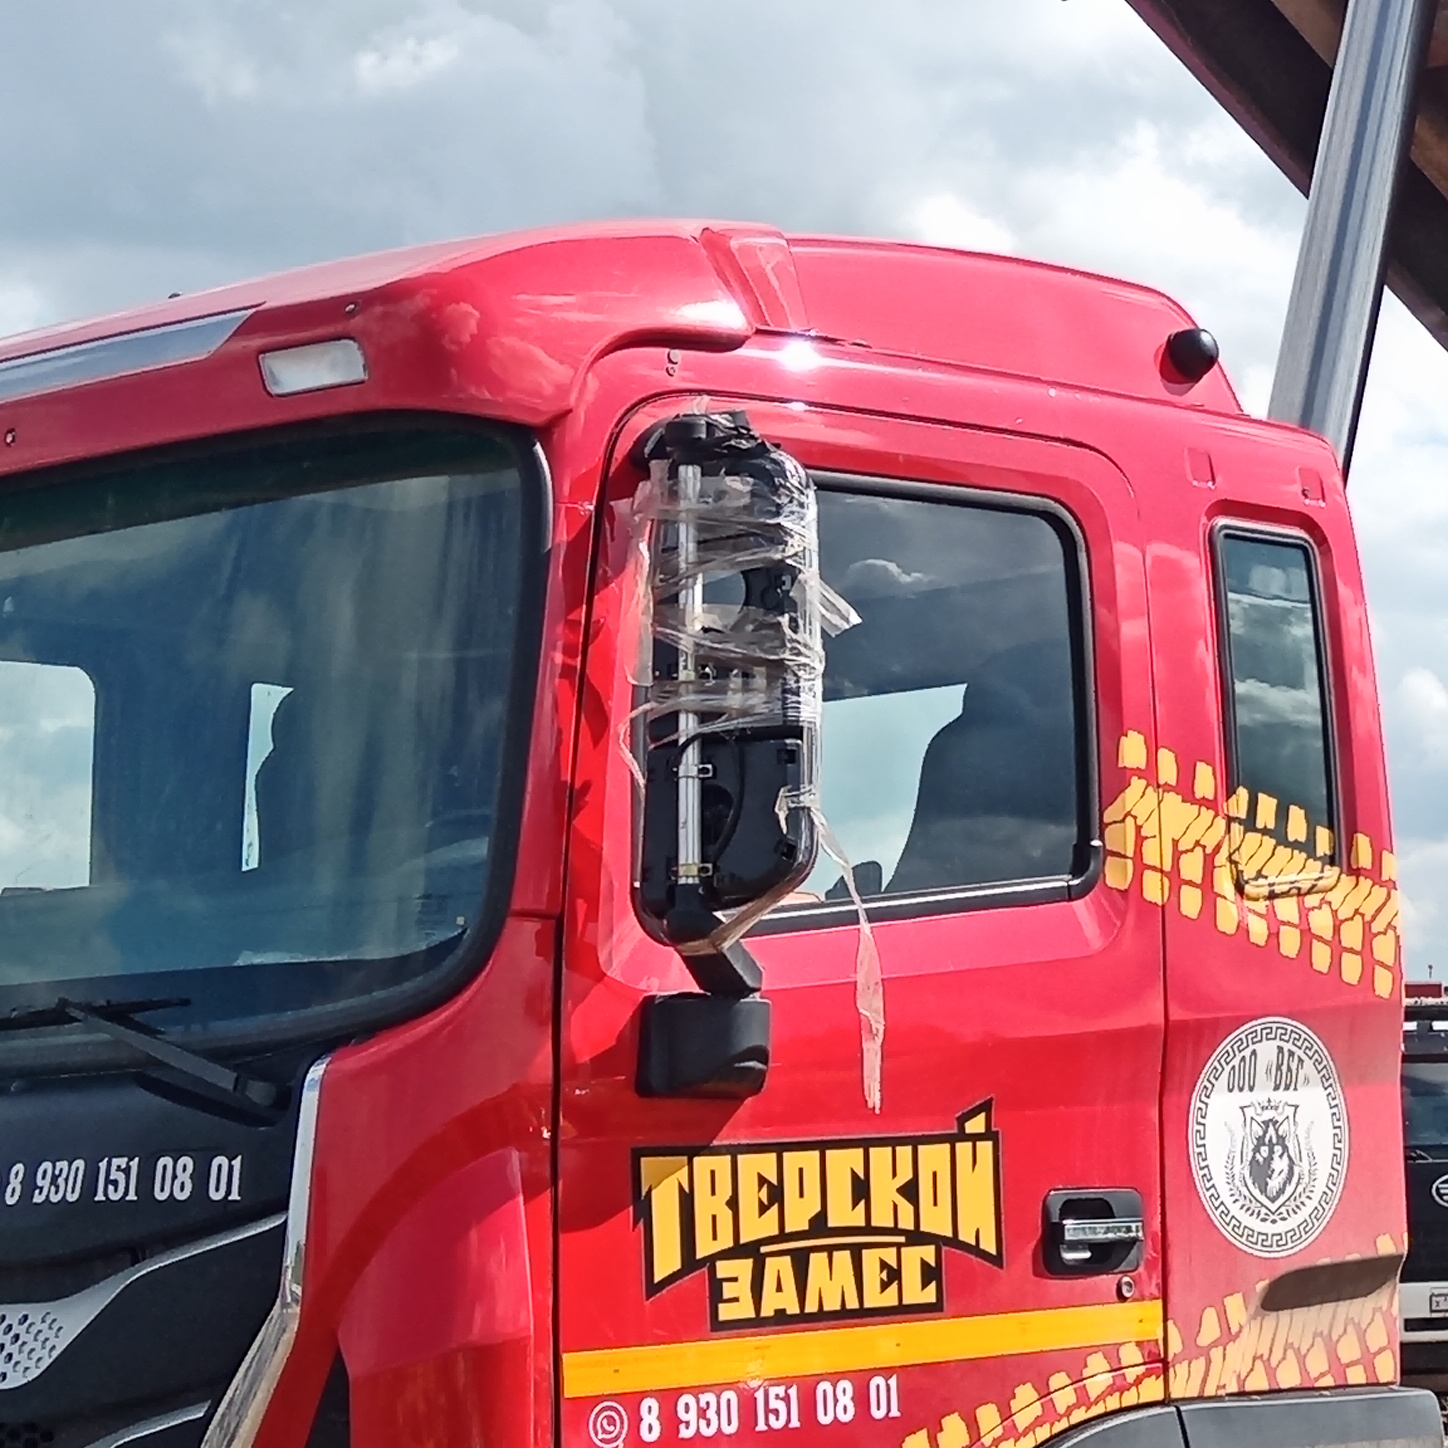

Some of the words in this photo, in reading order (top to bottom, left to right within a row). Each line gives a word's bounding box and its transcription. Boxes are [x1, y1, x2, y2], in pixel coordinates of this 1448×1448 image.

[1227, 1049, 1258, 1093] ООО
[5, 1163, 24, 1207] 8
[32, 1159, 85, 1204] 930
[94, 1156, 139, 1202] 151
[153, 1155, 195, 1202] 08
[208, 1153, 243, 1202] 01
[640, 1111, 998, 1285] ТВЕРСКОЙ
[715, 1244, 938, 1321] ЗАМЕС
[639, 1397, 661, 1442] 8
[677, 1390, 739, 1439] 930
[754, 1383, 801, 1432] 151
[815, 1379, 855, 1425] 08
[869, 1374, 901, 1420] 01
